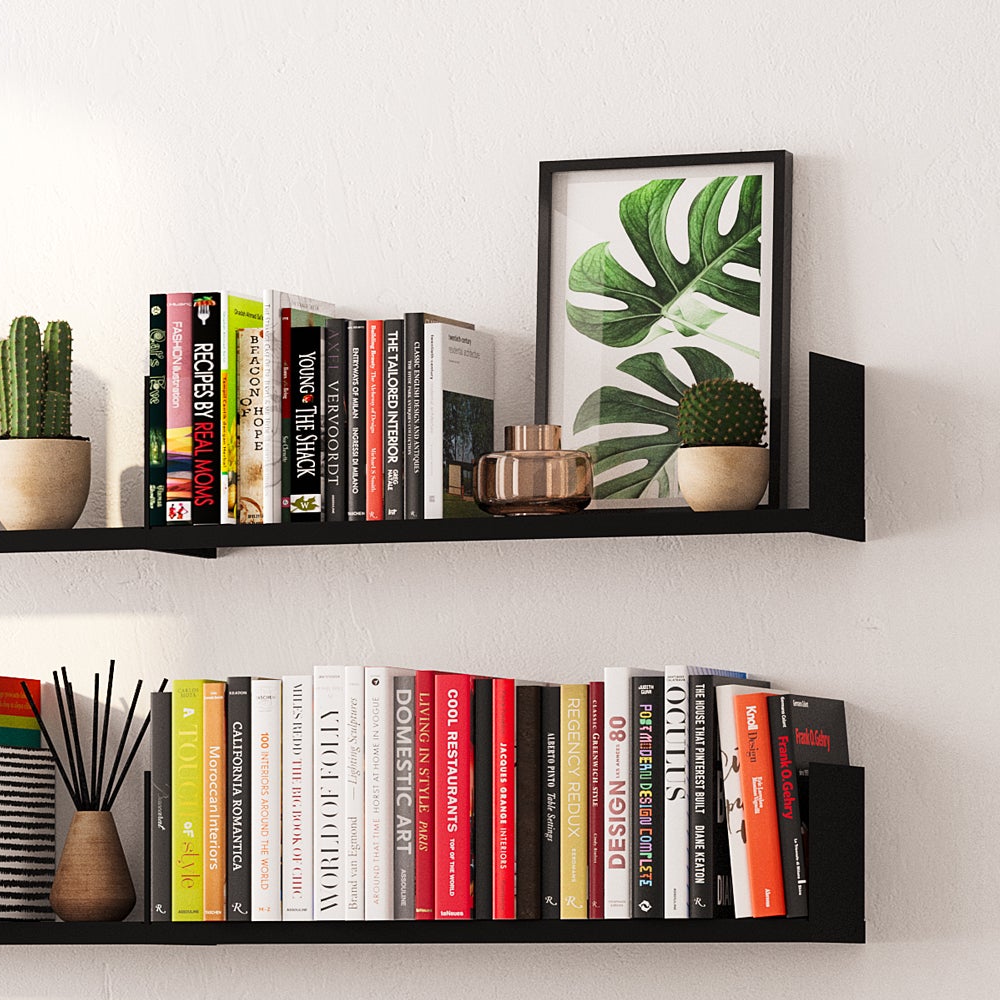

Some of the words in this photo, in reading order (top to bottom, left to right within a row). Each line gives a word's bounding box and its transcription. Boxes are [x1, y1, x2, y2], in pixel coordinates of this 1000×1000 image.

[172, 322, 182, 365] FASHION
[328, 328, 340, 370] AXEL
[387, 330, 399, 352] THE
[194, 343, 214, 399] RECIPES
[250, 336, 261, 398] BEACON
[298, 352, 316, 394] YOUNG
[387, 354, 399, 409] TAILORED
[172, 365, 181, 409] illustration
[194, 402, 214, 419] BY
[240, 398, 253, 418] OF
[295, 406, 318, 431] THE
[194, 422, 214, 457] REAL
[253, 406, 264, 452] HOPE
[328, 380, 340, 486] VERVOORDT
[387, 410, 399, 464] INTERIOR
[295, 434, 318, 479] SHACK
[194, 460, 214, 507] MOMS
[292, 682, 304, 720] MILES
[447, 688, 459, 727] COOL
[696, 684, 705, 699] THE
[348, 697, 361, 744] Sculptures
[372, 697, 380, 729] VOGUE
[418, 692, 430, 743] LIVING
[696, 700, 705, 725] HOUSE
[746, 706, 759, 731] Knoll
[260, 732, 270, 750] 100
[292, 722, 304, 756] REDD
[320, 710, 340, 780] FOLLY
[372, 731, 380, 741] IN
[396, 690, 412, 812] DOMESTIC
[418, 746, 430, 757] IN
[547, 732, 555, 764] ALBERTO
[568, 698, 581, 776] REGENCY
[639, 704, 653, 780] POSTMODERN
[666, 686, 687, 802] OCULUS
[696, 726, 705, 746] THAT
[746, 731, 759, 763] Design
[232, 722, 243, 797] CALIFORNIA
[260, 752, 270, 796] INTERIORS
[292, 758, 304, 785] THE
[348, 746, 361, 785] Lighting
[372, 743, 380, 771] HOME
[696, 748, 705, 790] PINTEREST
[372, 772, 380, 782] AT
[418, 767, 430, 813] STYLE
[447, 730, 459, 833] RESTAURANTS
[547, 766, 555, 788] PINTO
[292, 786, 304, 808] BIG
[320, 786, 340, 818] OF
[372, 786, 380, 814] HORST
[547, 792, 556, 813] Table
[568, 782, 581, 838] REDUX
[639, 782, 653, 826] DESIGN
[696, 792, 705, 814] BUILT
[232, 800, 243, 871] ROMANTICA
[260, 798, 270, 838] AROUND
[292, 810, 304, 846] BOOK
[372, 818, 380, 838] TIME
[396, 815, 412, 856] ART
[544, 814, 556, 842] Settings
[260, 840, 270, 856] THE
[348, 816, 361, 858] Egmond
[372, 840, 380, 863] THAT
[418, 820, 429, 852] PARIS
[696, 825, 705, 850] DIANE
[292, 848, 304, 866] OF
[320, 823, 340, 912] WORLD
[350, 860, 359, 881] van
[449, 851, 455, 861] OF
[639, 828, 653, 887] COMPLETE
[696, 852, 705, 884] KEATON
[260, 858, 270, 891] WORLD
[292, 867, 304, 900] CHIC
[372, 865, 380, 905] AROUND
[348, 883, 359, 911] Brand
